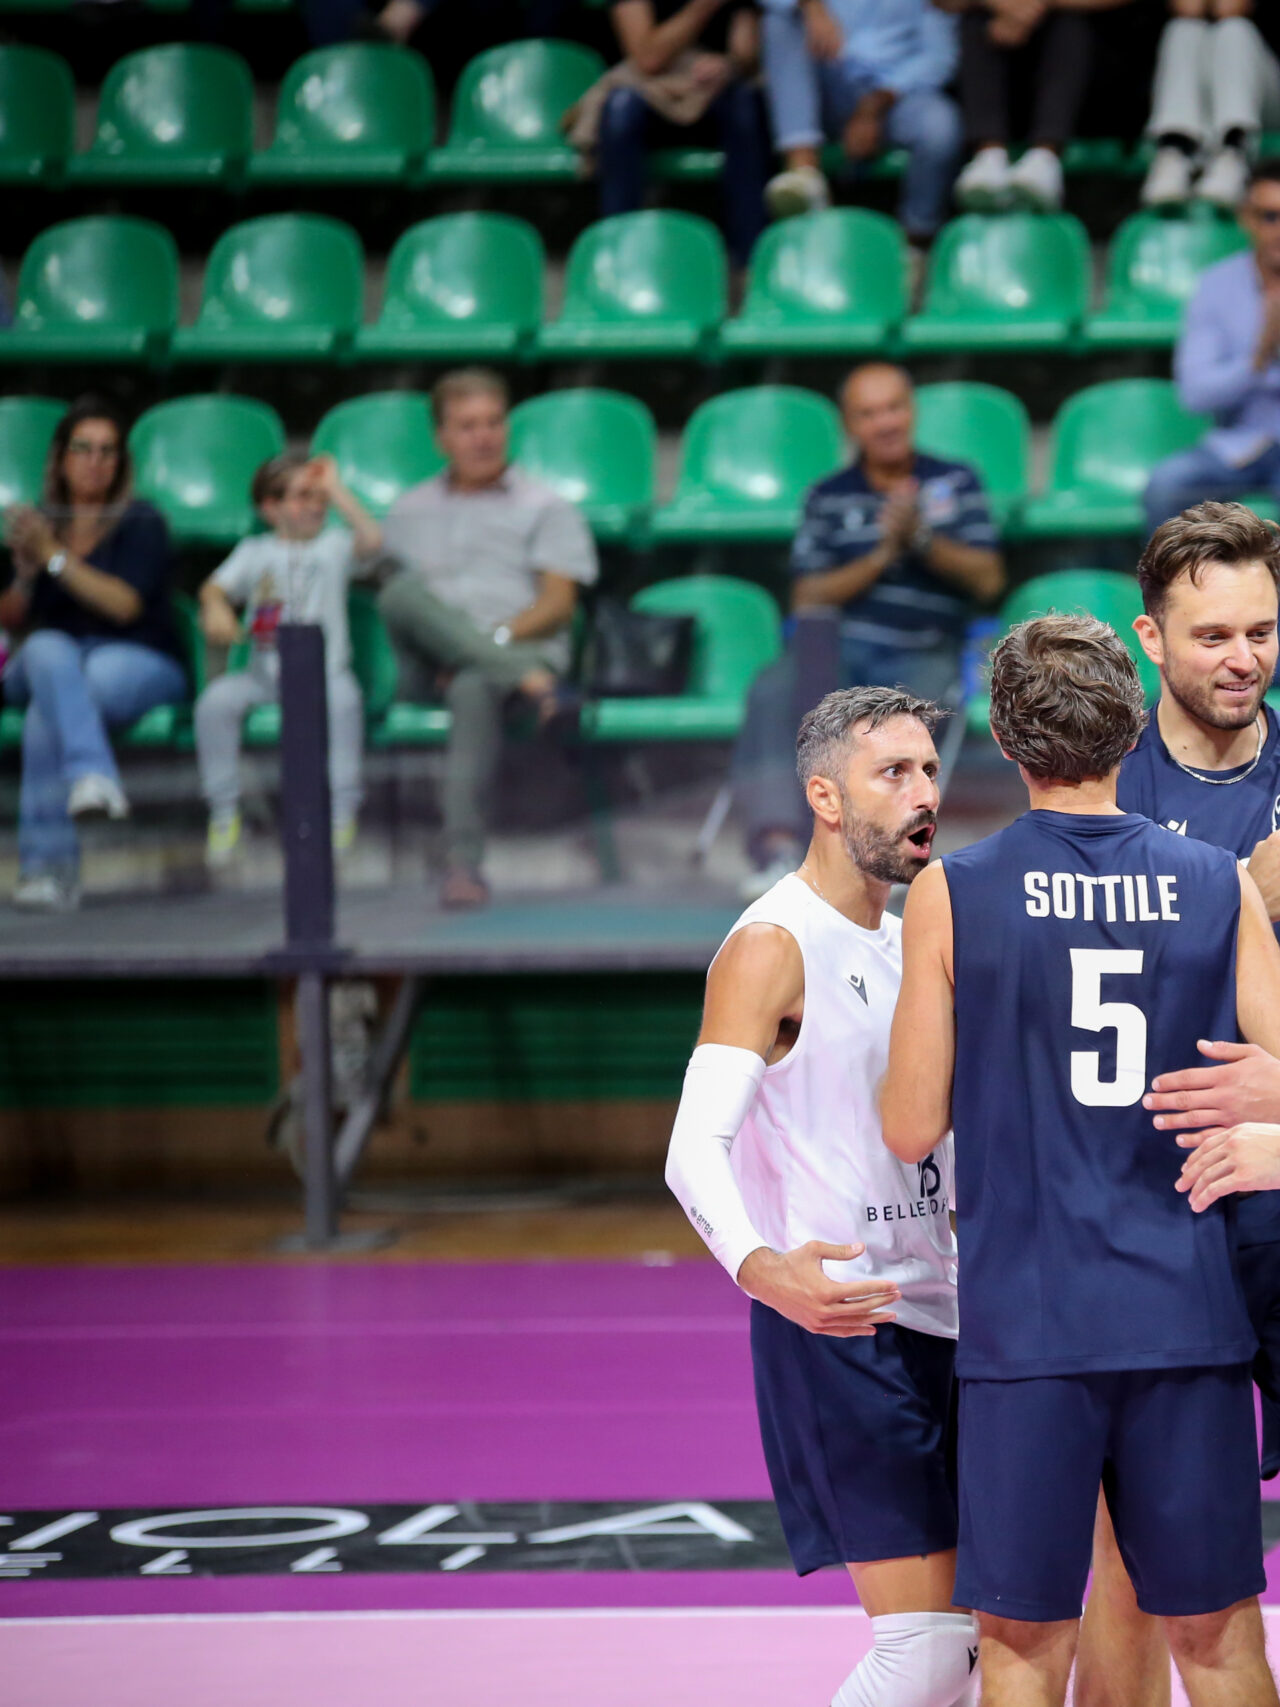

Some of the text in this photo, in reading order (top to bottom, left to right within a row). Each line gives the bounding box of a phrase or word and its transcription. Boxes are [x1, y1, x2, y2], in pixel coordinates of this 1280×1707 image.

[1023, 871, 1180, 922] SOTTILE
[1069, 948, 1147, 1107] 5
[0, 1502, 754, 1551] IOLA
